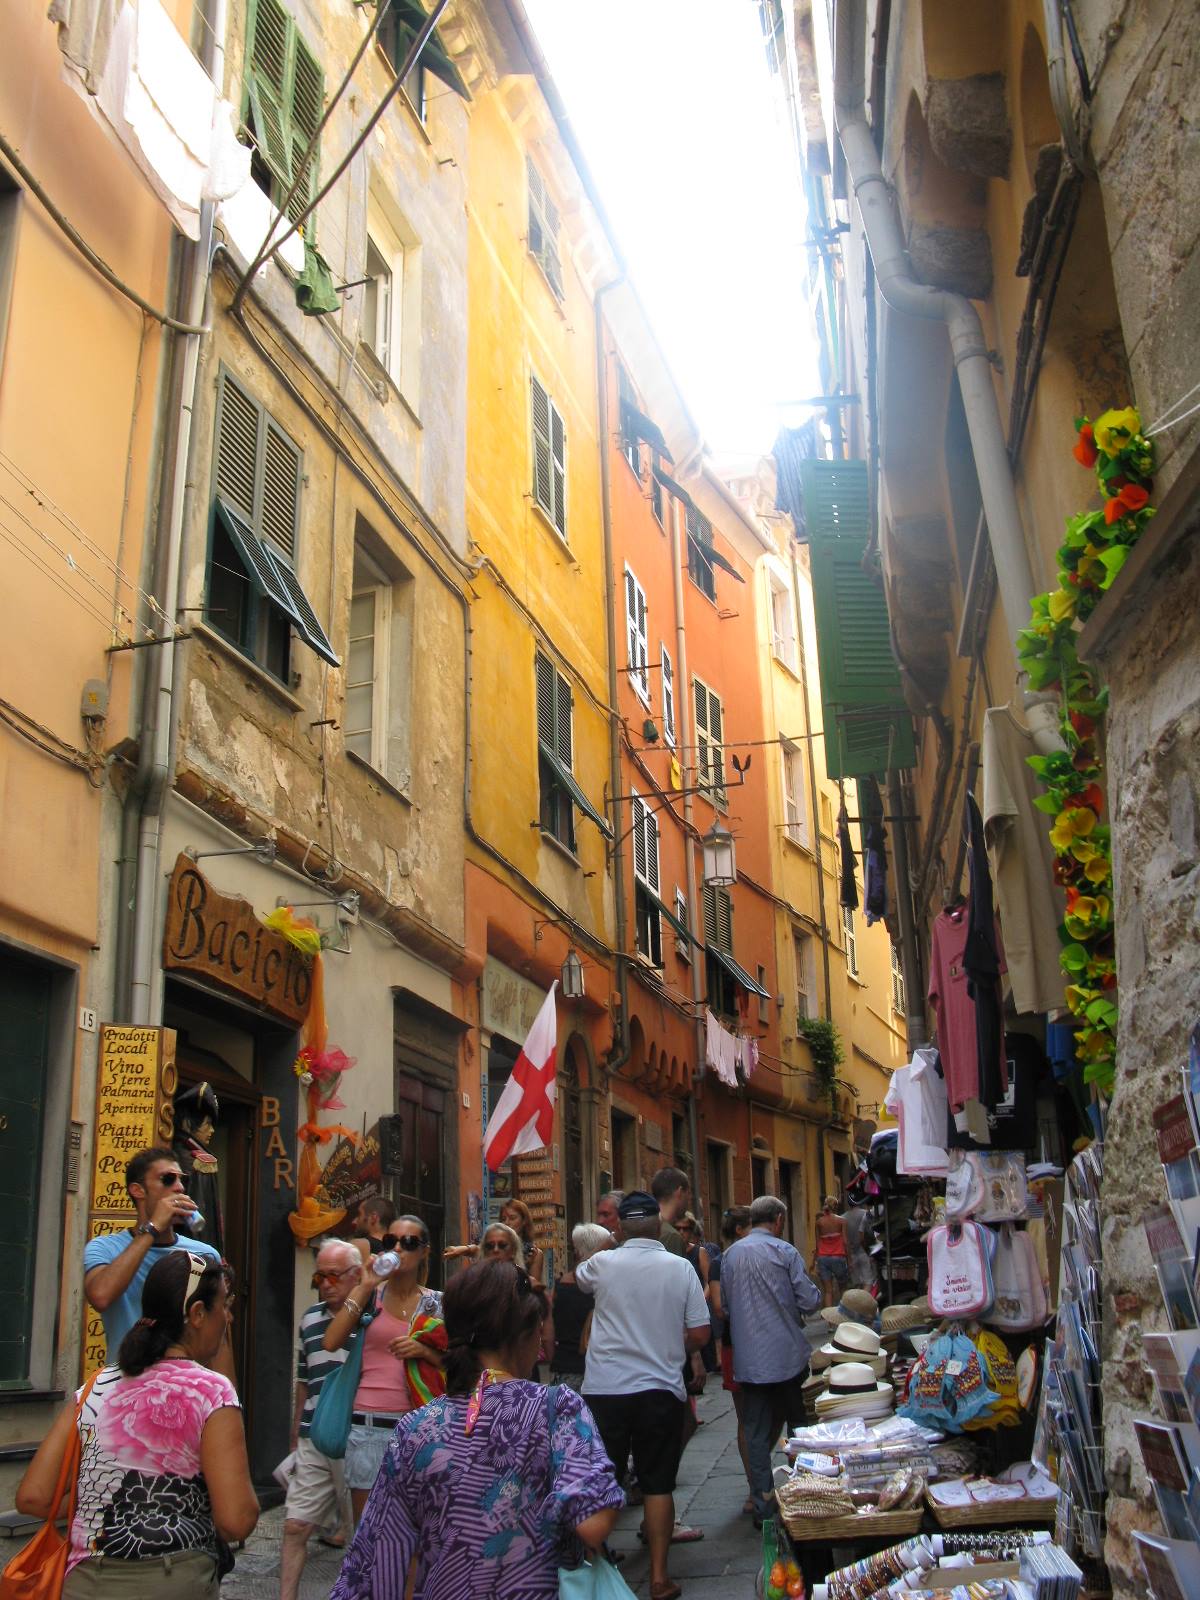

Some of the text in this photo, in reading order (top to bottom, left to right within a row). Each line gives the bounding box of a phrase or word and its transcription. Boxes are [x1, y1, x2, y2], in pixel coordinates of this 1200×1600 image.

[83, 1011, 93, 1027] 15
[104, 1028, 156, 1041] Prodotti
[105, 1041, 148, 1054] Locali
[105, 1058, 144, 1074] Vino
[109, 1073, 151, 1086] 5 terre
[101, 1085, 154, 1098] Palmaria
[100, 1102, 154, 1116] Aperitivi
[99, 1122, 144, 1137] Piatti
[112, 1136, 148, 1152] Tipici
[261, 1096, 295, 1189] BAR
[99, 1155, 130, 1173] Pes
